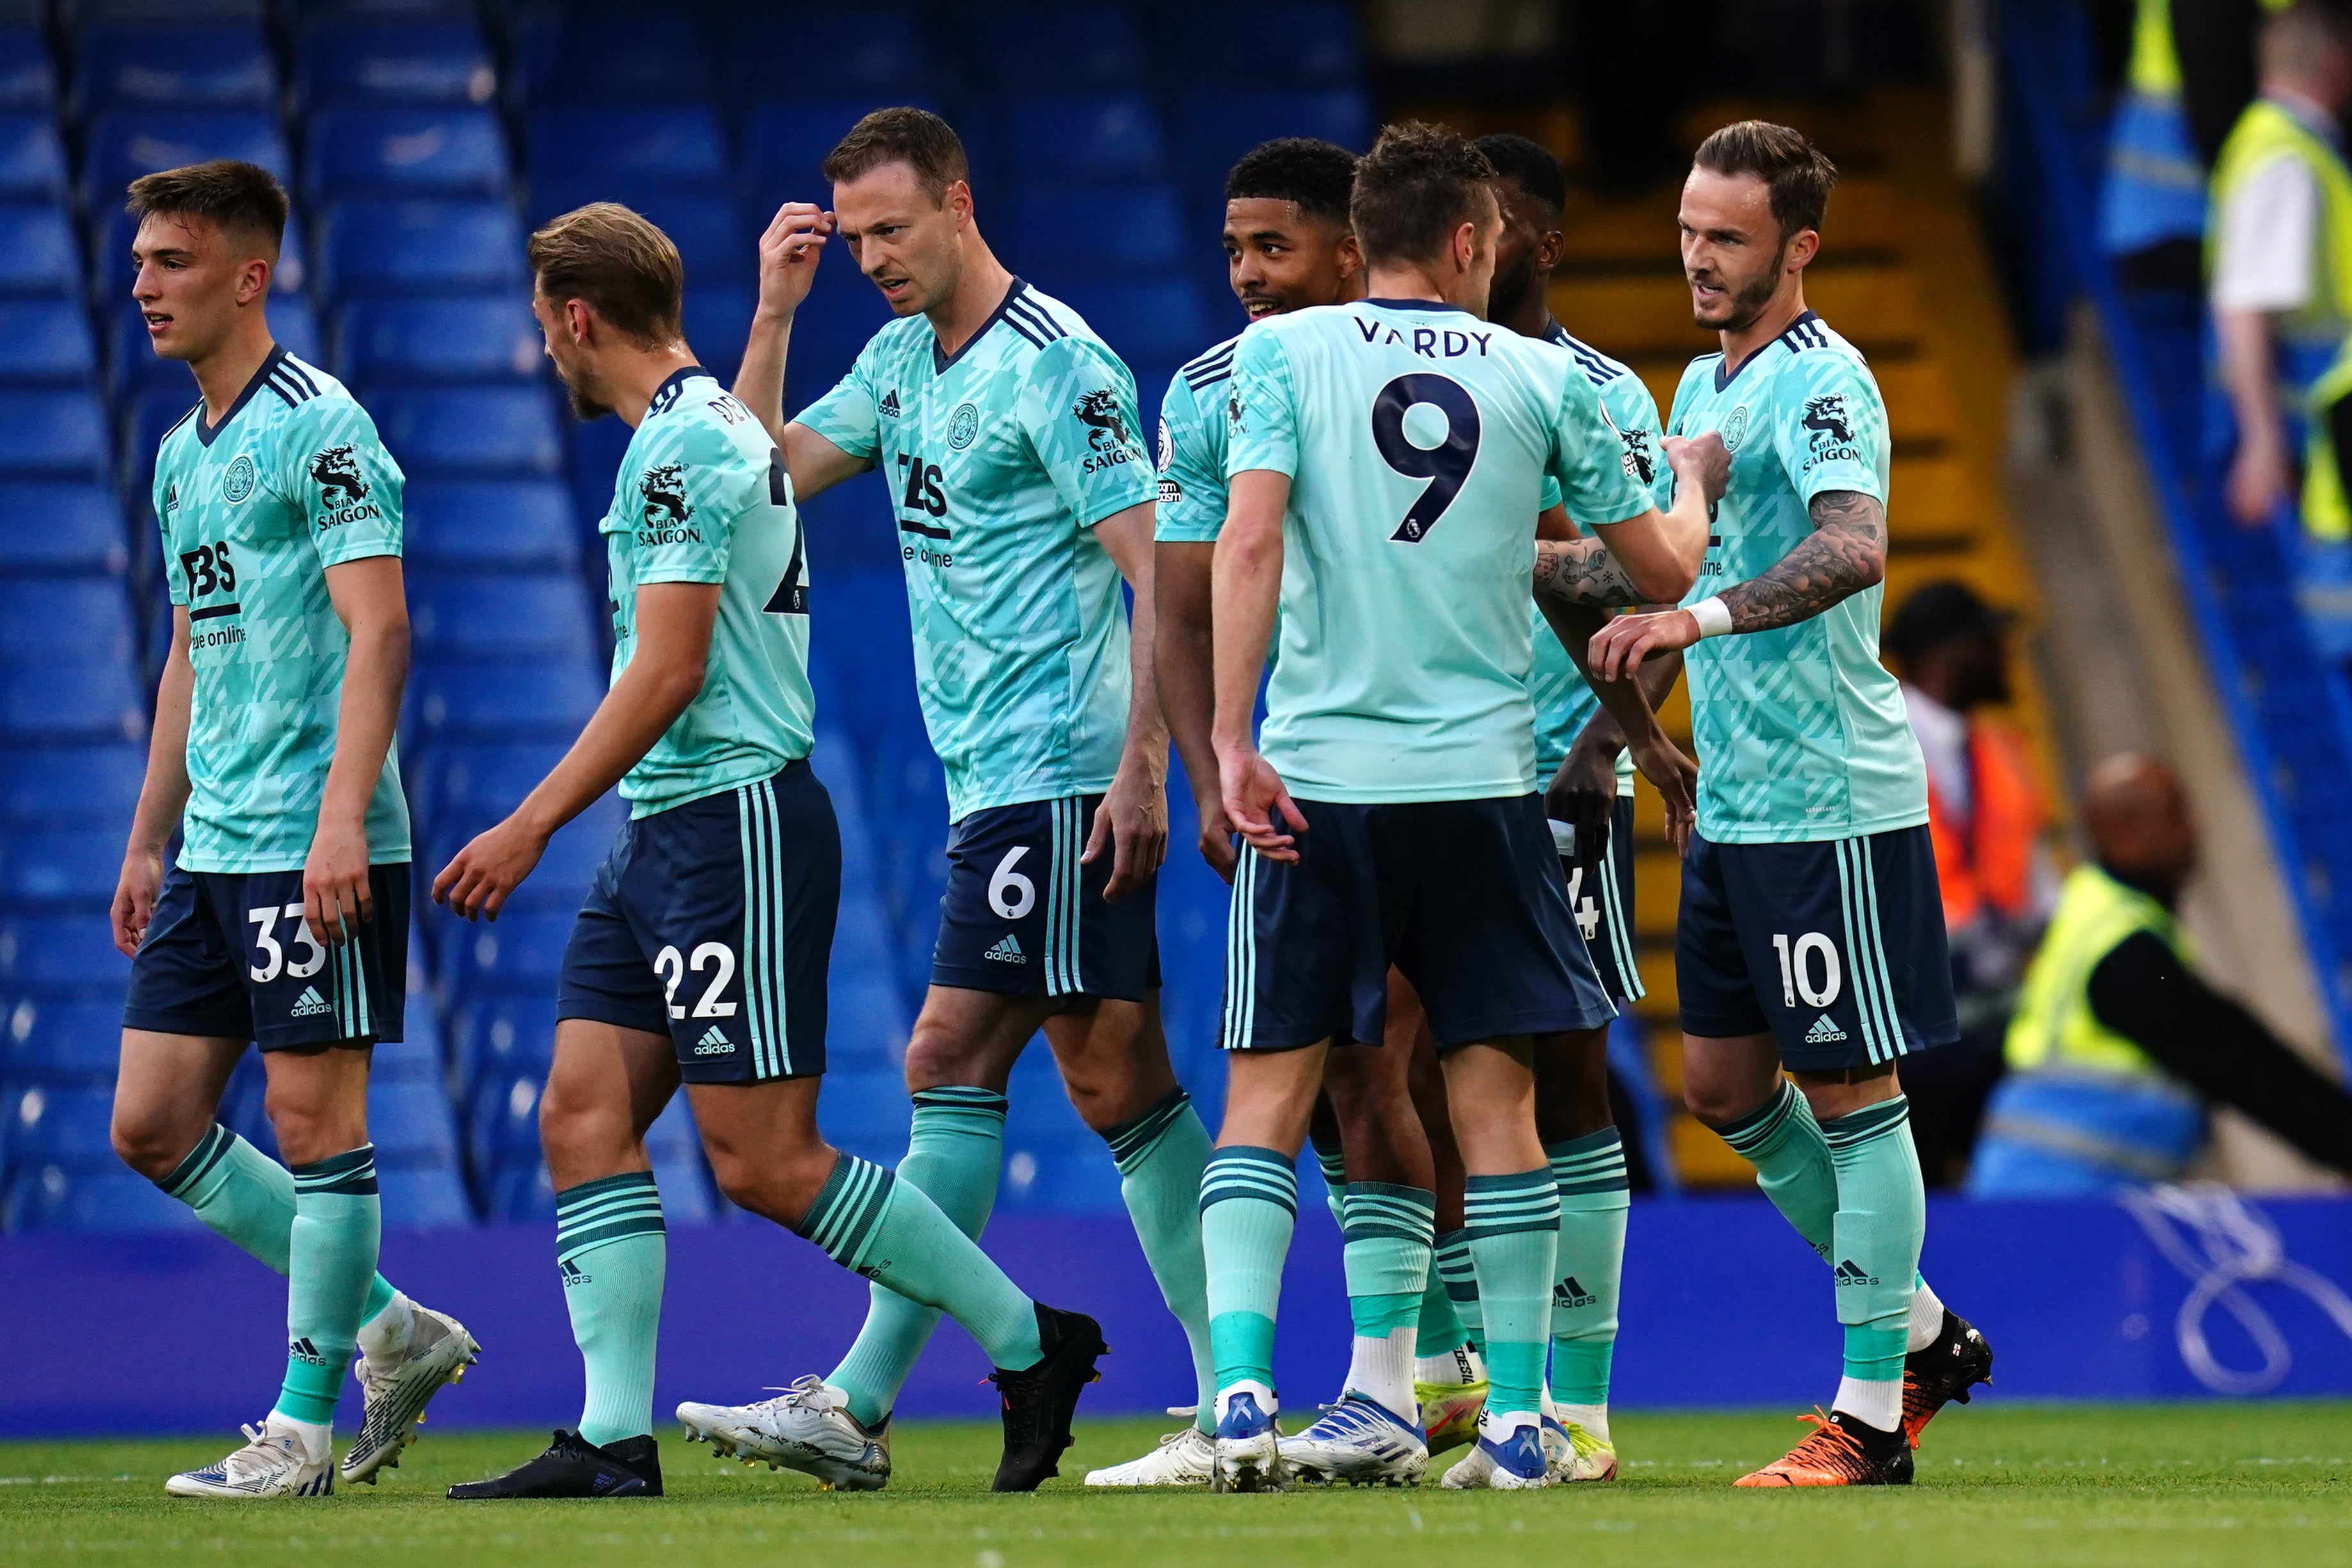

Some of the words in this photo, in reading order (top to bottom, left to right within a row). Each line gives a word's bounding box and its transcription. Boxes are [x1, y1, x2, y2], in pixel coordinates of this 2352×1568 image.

[1353, 316, 1493, 358] VARDY
[878, 405, 901, 419] adida
[1818, 439, 1839, 450] BIA
[1083, 448, 1143, 474] SAIGON
[1370, 371, 1483, 545] 9
[1802, 448, 1863, 476] SAIGON
[335, 497, 354, 510] BIA
[317, 504, 380, 531] SAIGON
[656, 517, 677, 529] BIA
[638, 528, 701, 546] SAIGON
[988, 846, 1035, 919] 6
[248, 903, 326, 983] 33
[983, 951, 1027, 964] adidas
[1772, 931, 1841, 1008] 10
[653, 941, 738, 1020] 22
[290, 1003, 332, 1017] adidas
[1804, 1031, 1848, 1043] adidas
[694, 1042, 736, 1055] adidas
[289, 1349, 327, 1366] didas
